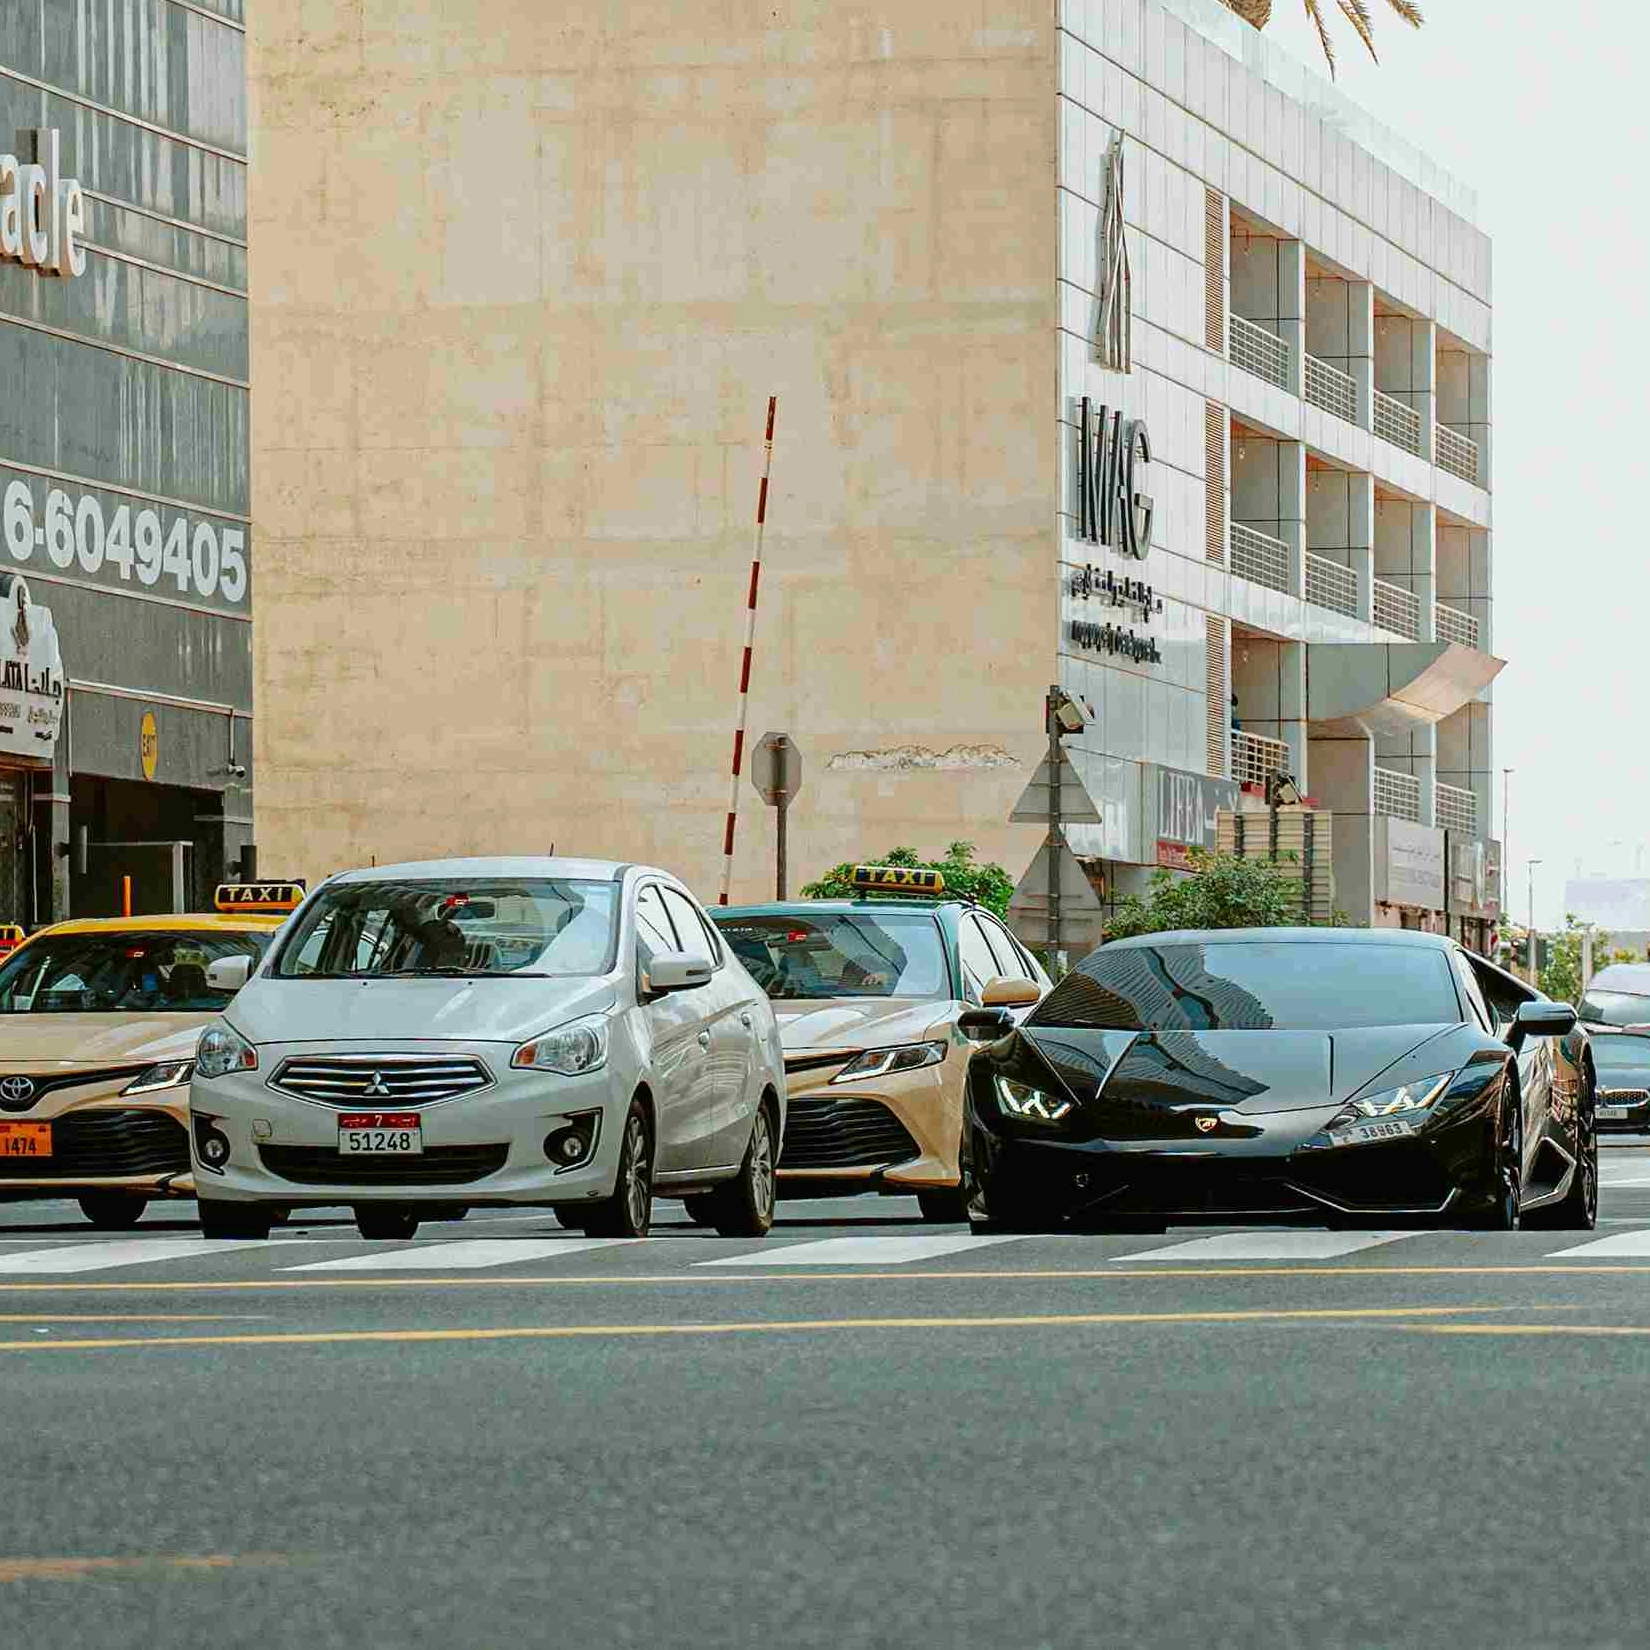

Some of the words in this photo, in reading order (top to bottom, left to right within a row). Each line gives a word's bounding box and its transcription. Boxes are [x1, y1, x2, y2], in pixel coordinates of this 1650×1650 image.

[867, 869, 926, 884] TAXI
[228, 887, 283, 901] TAXI
[375, 1114, 383, 1127] 7
[5, 1137, 38, 1155] 1474
[349, 1132, 411, 1151] 51248
